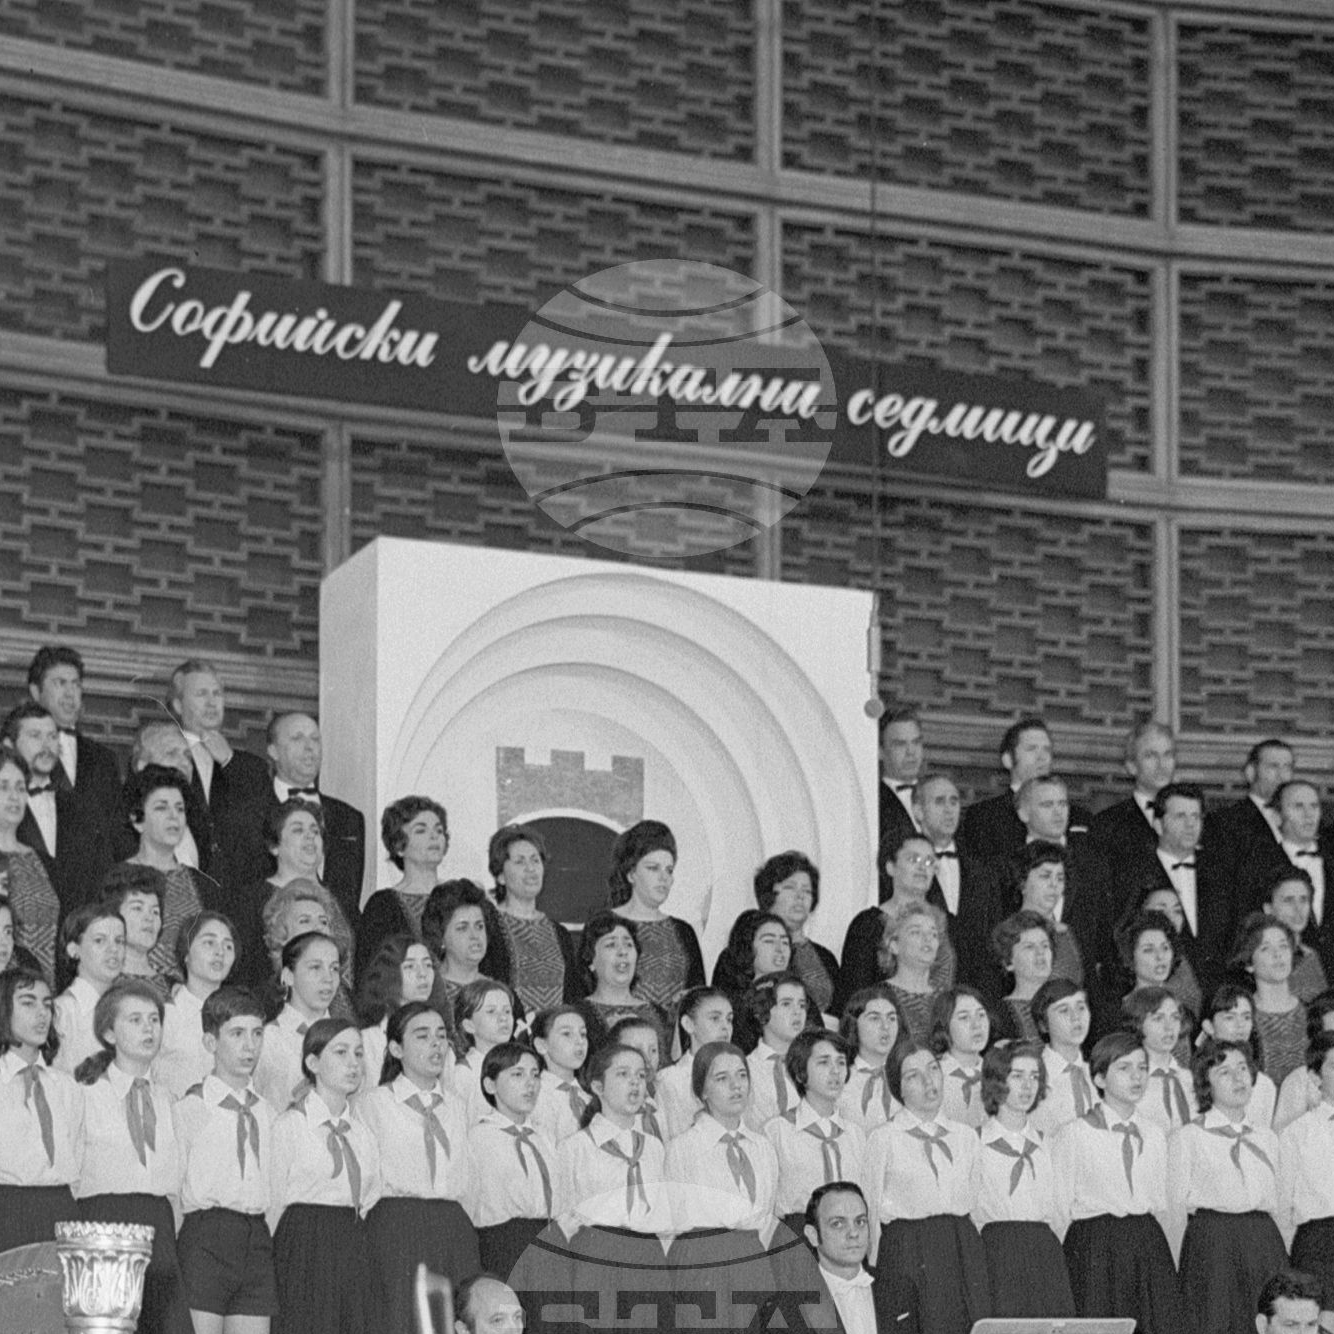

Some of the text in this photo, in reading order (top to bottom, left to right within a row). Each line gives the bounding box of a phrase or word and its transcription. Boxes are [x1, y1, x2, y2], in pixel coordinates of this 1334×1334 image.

[129, 267, 1097, 479] Софийски музикални седмици
